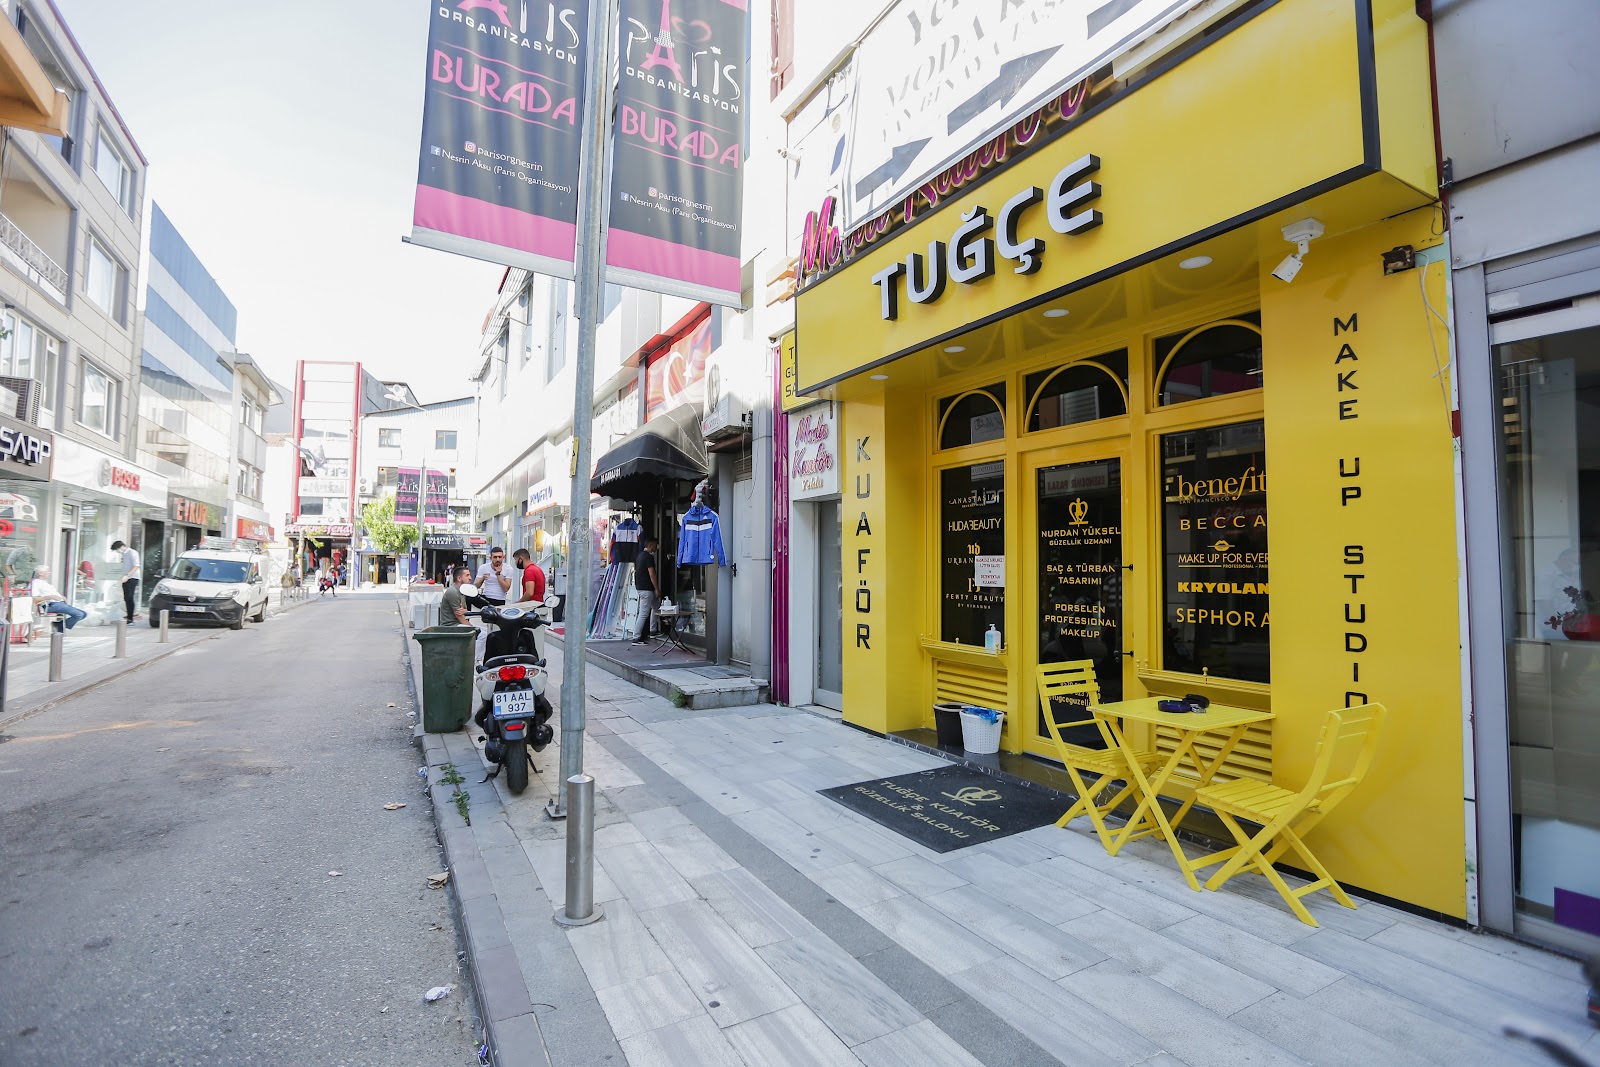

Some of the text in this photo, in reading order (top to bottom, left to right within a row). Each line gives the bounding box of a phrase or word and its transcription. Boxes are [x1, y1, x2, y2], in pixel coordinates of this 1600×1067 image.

[439, 6, 577, 65] ORGANİZASYON
[432, 49, 577, 126] BURADA
[626, 66, 739, 114] ORGANİZASYON
[622, 105, 739, 169] BURADA
[477, 147, 543, 172] parisorgnesrin
[441, 149, 572, 194] Nesrin Aksu (Paris Organizasyon)
[658, 191, 713, 212] parisorgnesrin
[629, 194, 737, 231] Nesrin Aksu (Paris Organizasyon)
[871, 153, 1103, 320] TUĞÇE
[114, 468, 141, 491] BOSCH
[1177, 466, 1267, 501] benefit
[1333, 313, 1368, 709] MAKE UP STUDIO
[1041, 525, 1121, 538] NURDAN YÜKSEL
[1180, 515, 1267, 530] BECCA
[855, 436, 872, 650] KUAFÖR
[1049, 537, 1081, 546] GÜZELLİK
[947, 557, 974, 566] URBAN
[1178, 552, 1269, 563] MAKE UP FOR EVER
[1046, 564, 1063, 575] SAÇ
[1076, 562, 1115, 573] TÜRBAN
[1058, 576, 1101, 585] TASARIMI
[1177, 581, 1269, 594] KRYOLAN
[946, 593, 1004, 603] FENTY BEAUTY
[1055, 603, 1106, 614] PORSELEN
[1045, 614, 1117, 627] PROFESSIONAL
[1176, 607, 1270, 628] SEPHORA
[1060, 628, 1100, 638] MAKEUP
[496, 692, 531, 703] 81 AAL
[508, 702, 526, 713] 937
[854, 786, 969, 839] GÜZELLİK SALONU
[878, 781, 1001, 832] TUĞÇE KUAFÖR
